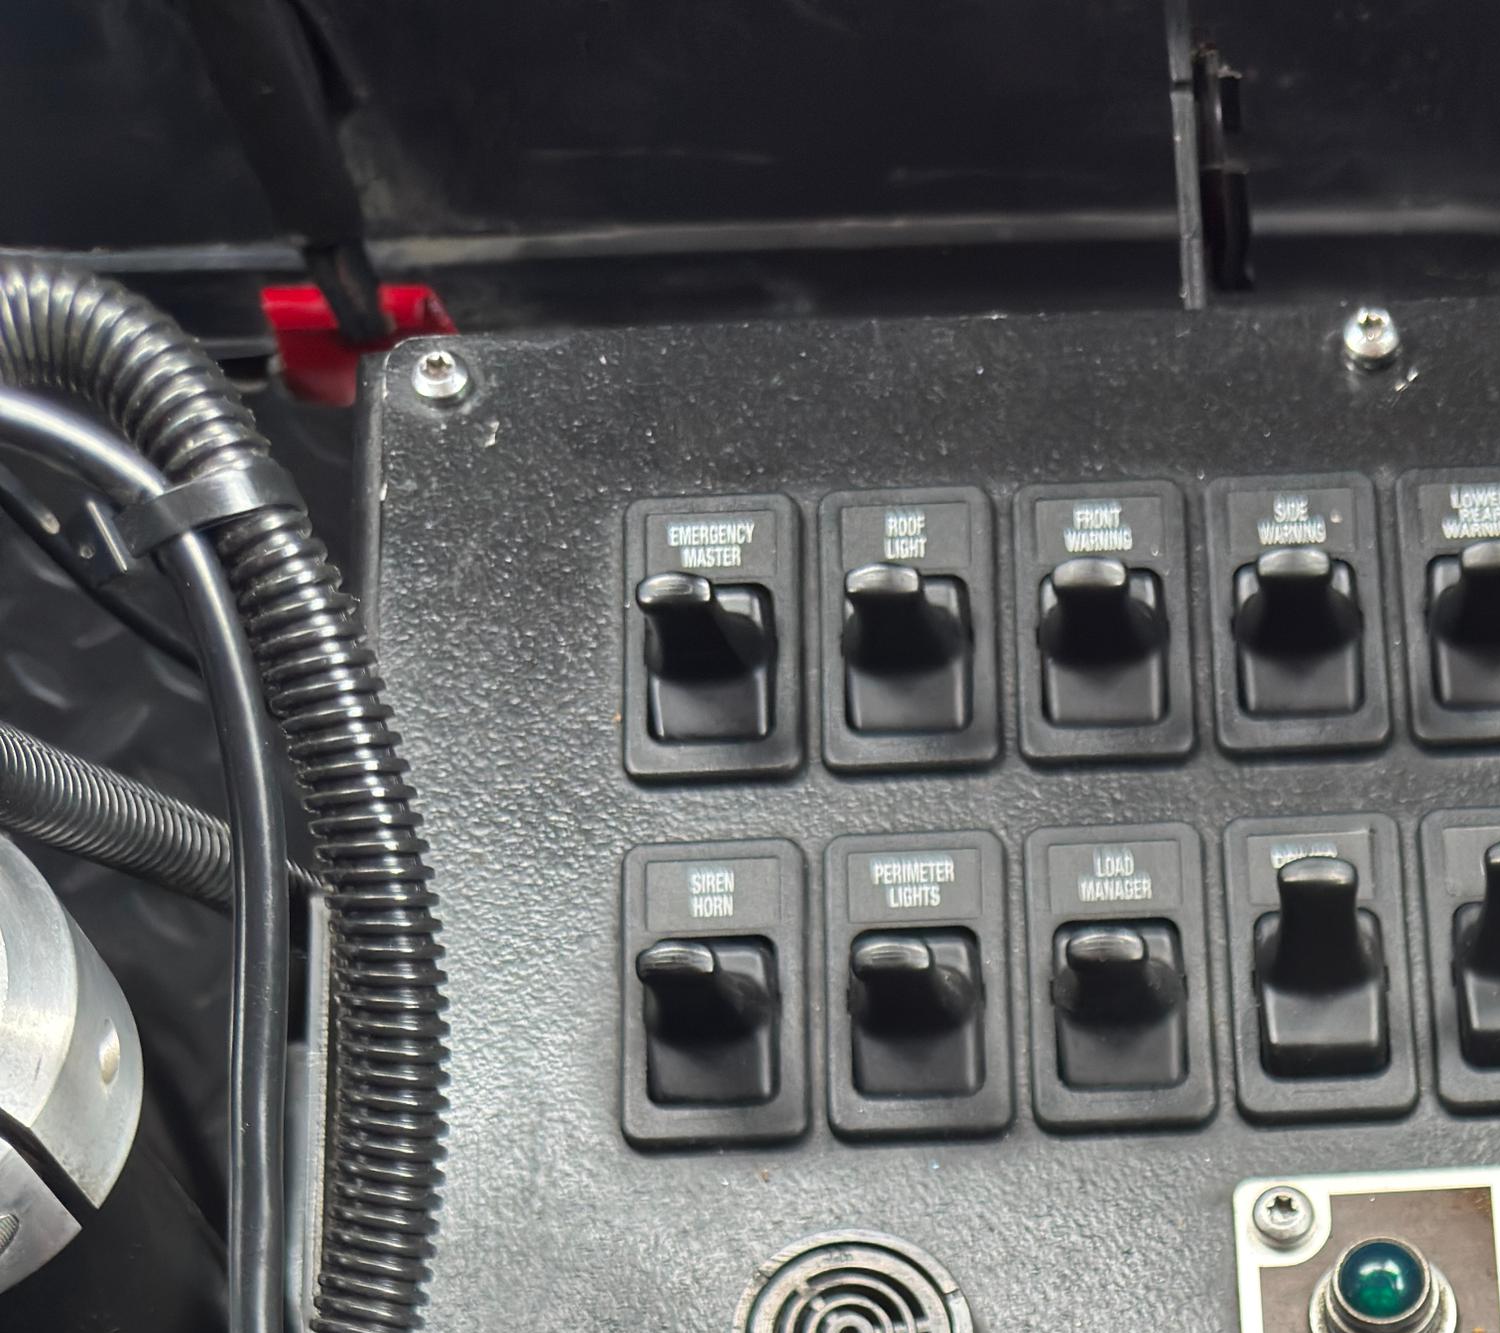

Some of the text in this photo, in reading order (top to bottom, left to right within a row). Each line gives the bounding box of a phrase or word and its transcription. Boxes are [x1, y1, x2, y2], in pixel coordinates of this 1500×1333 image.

[1073, 501, 1122, 528] FRONT
[1273, 495, 1309, 523] SIDE
[668, 520, 756, 546] EMERGENCY
[884, 511, 926, 537] ROOF
[1257, 518, 1326, 545] WARNING
[884, 536, 927, 560] LIGHT
[1064, 526, 1133, 553] WARNING
[681, 545, 742, 568] MASTER
[871, 857, 955, 886] PERIMETER
[1094, 849, 1135, 878] LOAD
[689, 870, 736, 893] SIREN
[1079, 876, 1152, 902] MANAGER
[692, 893, 735, 918] HORN
[886, 883, 941, 908] LIGHTS
